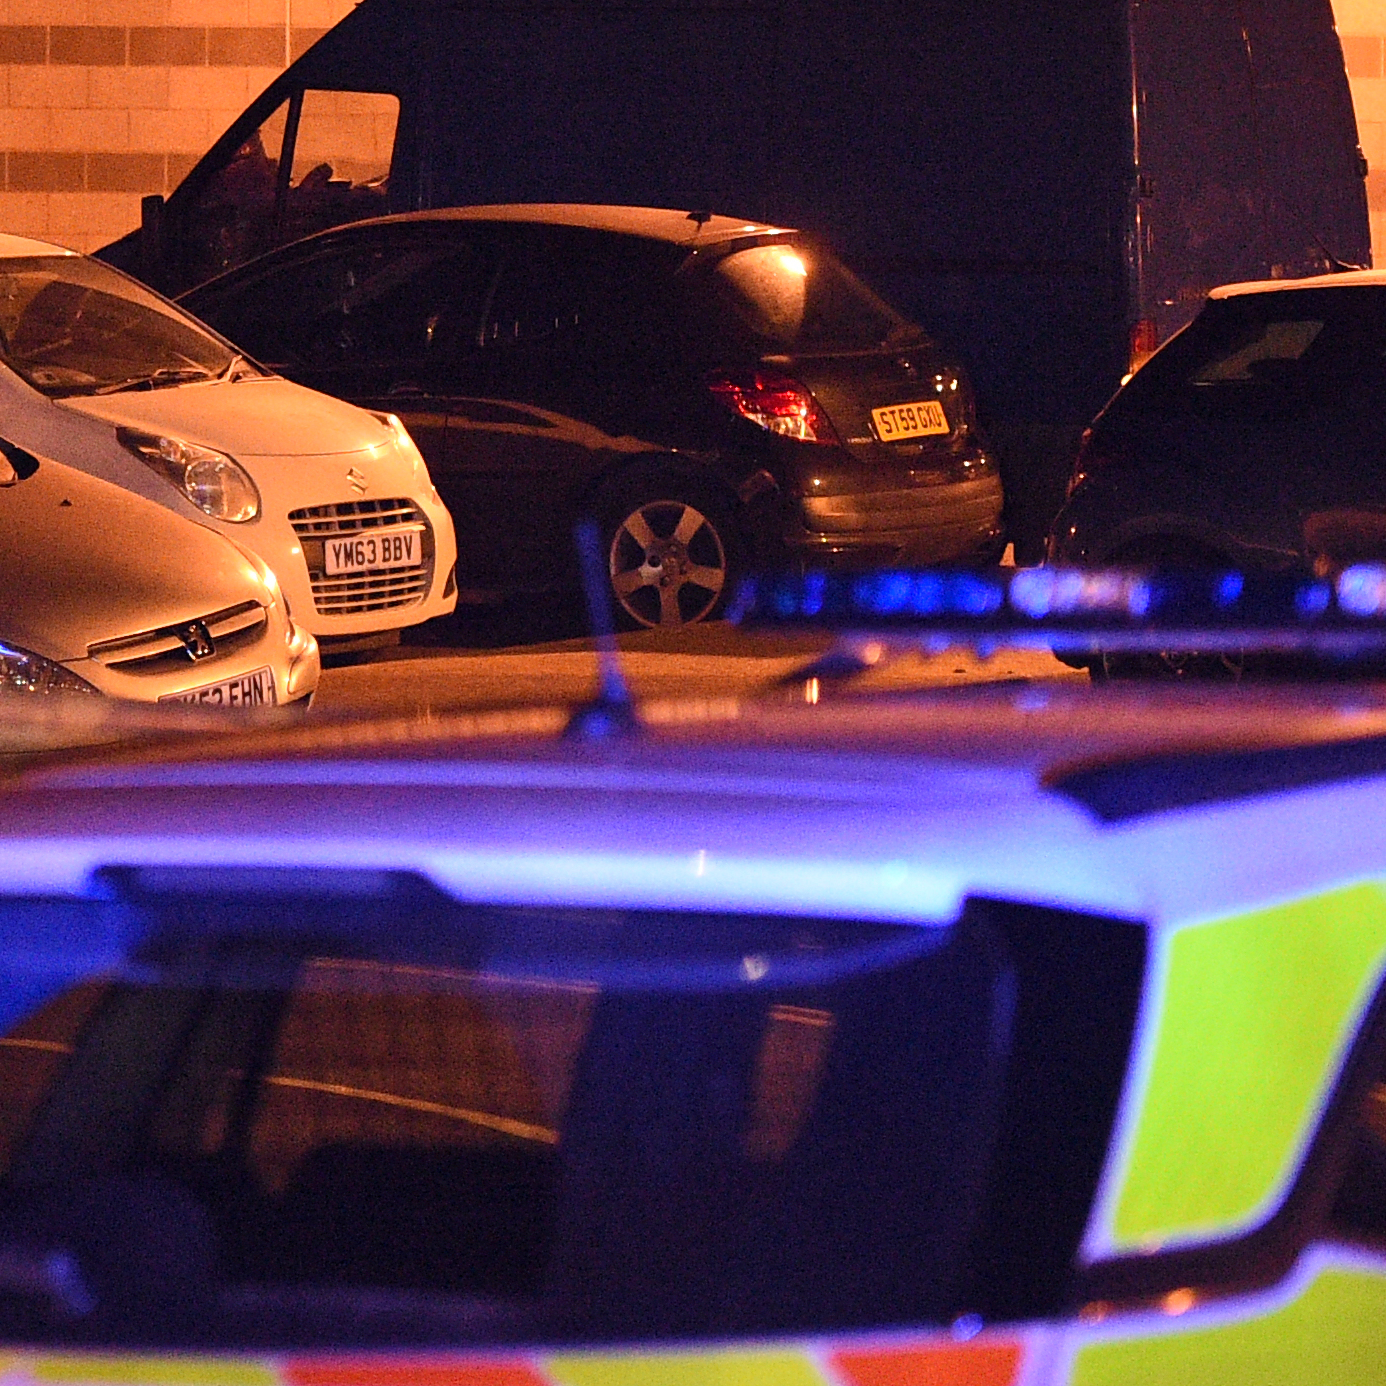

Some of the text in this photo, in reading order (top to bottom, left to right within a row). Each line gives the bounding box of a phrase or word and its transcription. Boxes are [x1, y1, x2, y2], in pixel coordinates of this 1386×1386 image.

[879, 404, 943, 434] ST59 GXU
[332, 534, 413, 569] YM63 BBV
[229, 674, 264, 707] EHN
